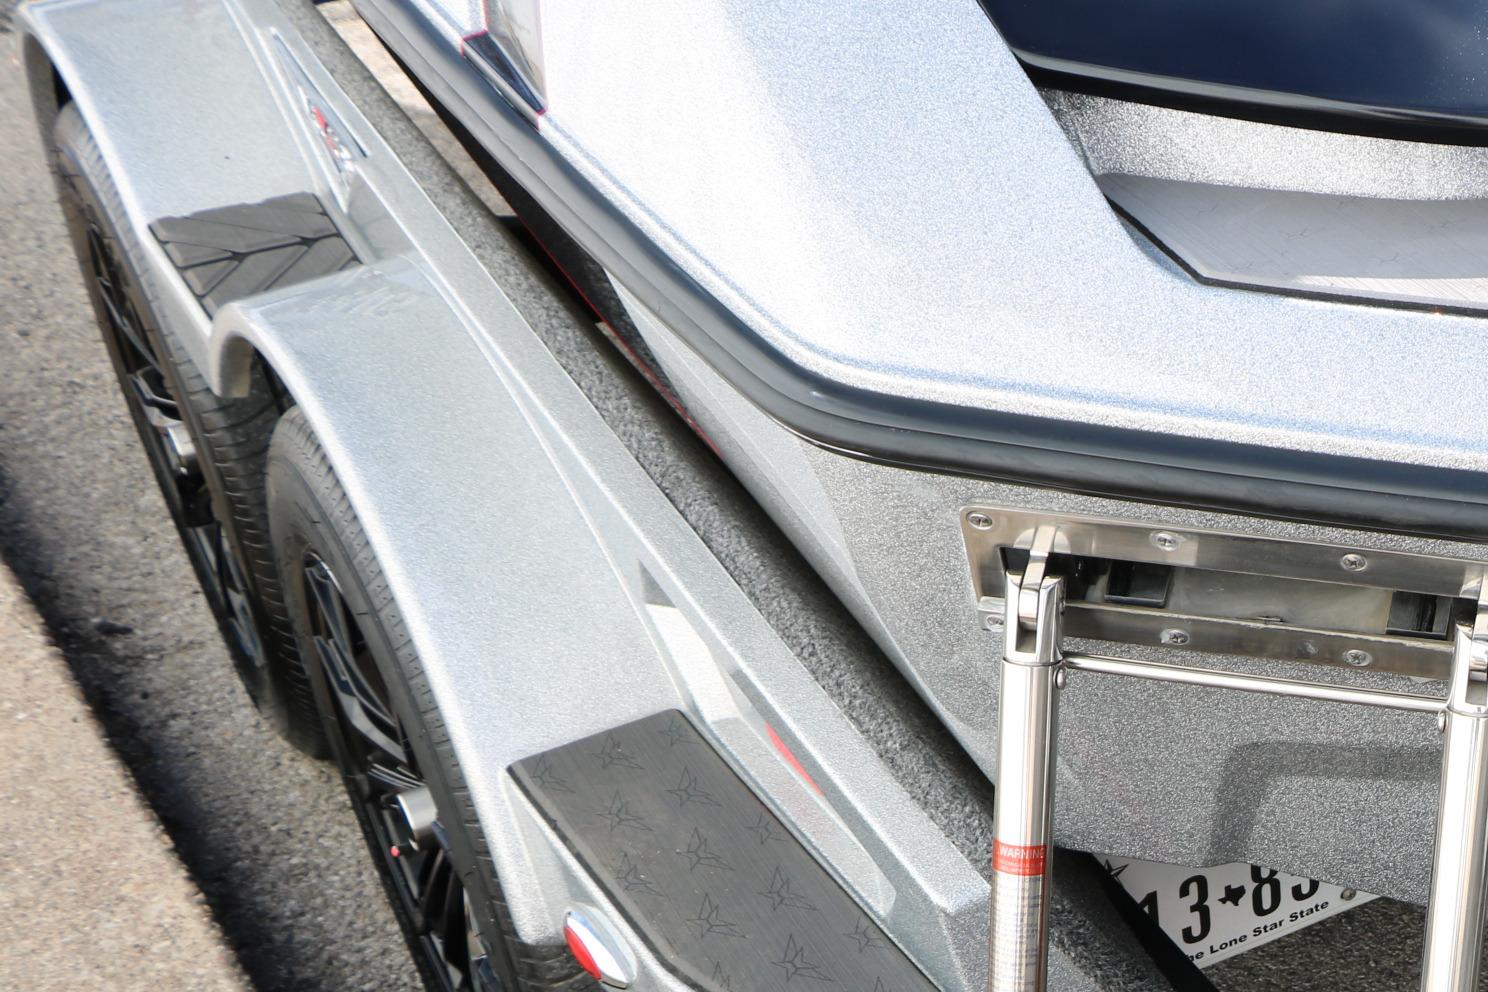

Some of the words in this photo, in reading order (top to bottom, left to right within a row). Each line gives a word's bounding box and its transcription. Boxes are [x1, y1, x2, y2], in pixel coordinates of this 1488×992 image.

[999, 844, 1046, 860] WARNING
[1209, 934, 1248, 955] Lone
[1252, 919, 1285, 938] Star
[1289, 901, 1330, 923] State
